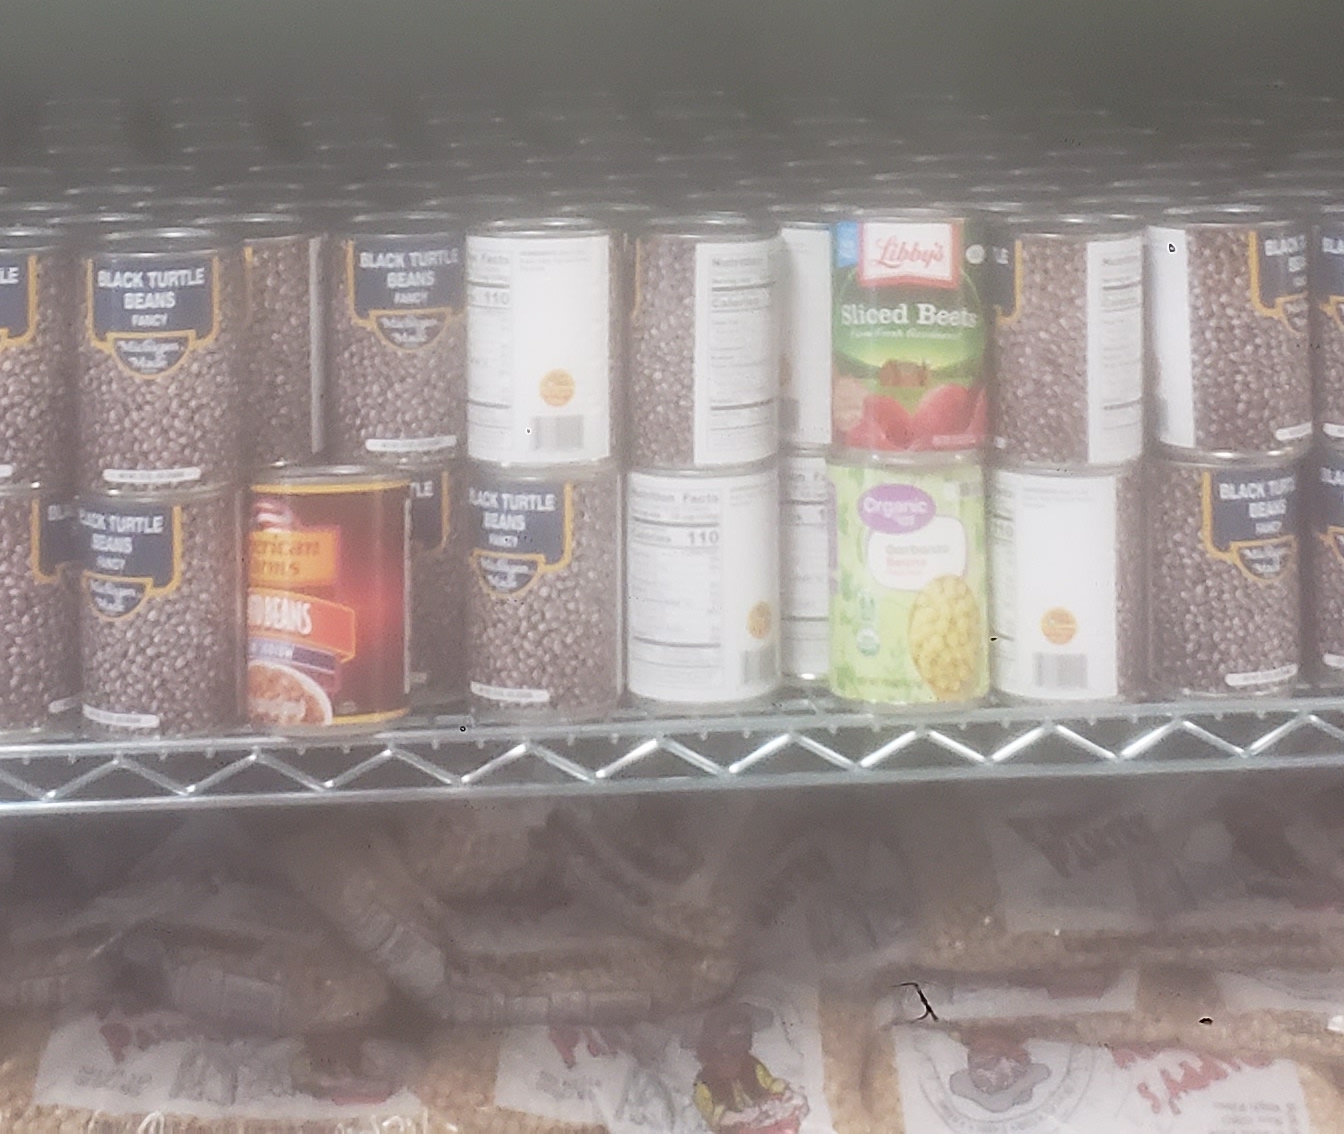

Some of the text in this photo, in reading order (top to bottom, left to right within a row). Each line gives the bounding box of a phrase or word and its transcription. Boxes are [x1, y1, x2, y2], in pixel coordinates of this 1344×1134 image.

[359, 252, 404, 268] BLACK
[871, 235, 945, 269] Libby's
[97, 267, 205, 289] BLACK TURTLE
[387, 271, 435, 289] BEANS
[123, 291, 176, 310] BEANS
[840, 302, 978, 328] Sliced Beets
[1219, 482, 1266, 500] BLACK
[501, 492, 557, 511] TURTLE
[109, 514, 165, 533] TURTLE
[688, 531, 719, 544] 110
